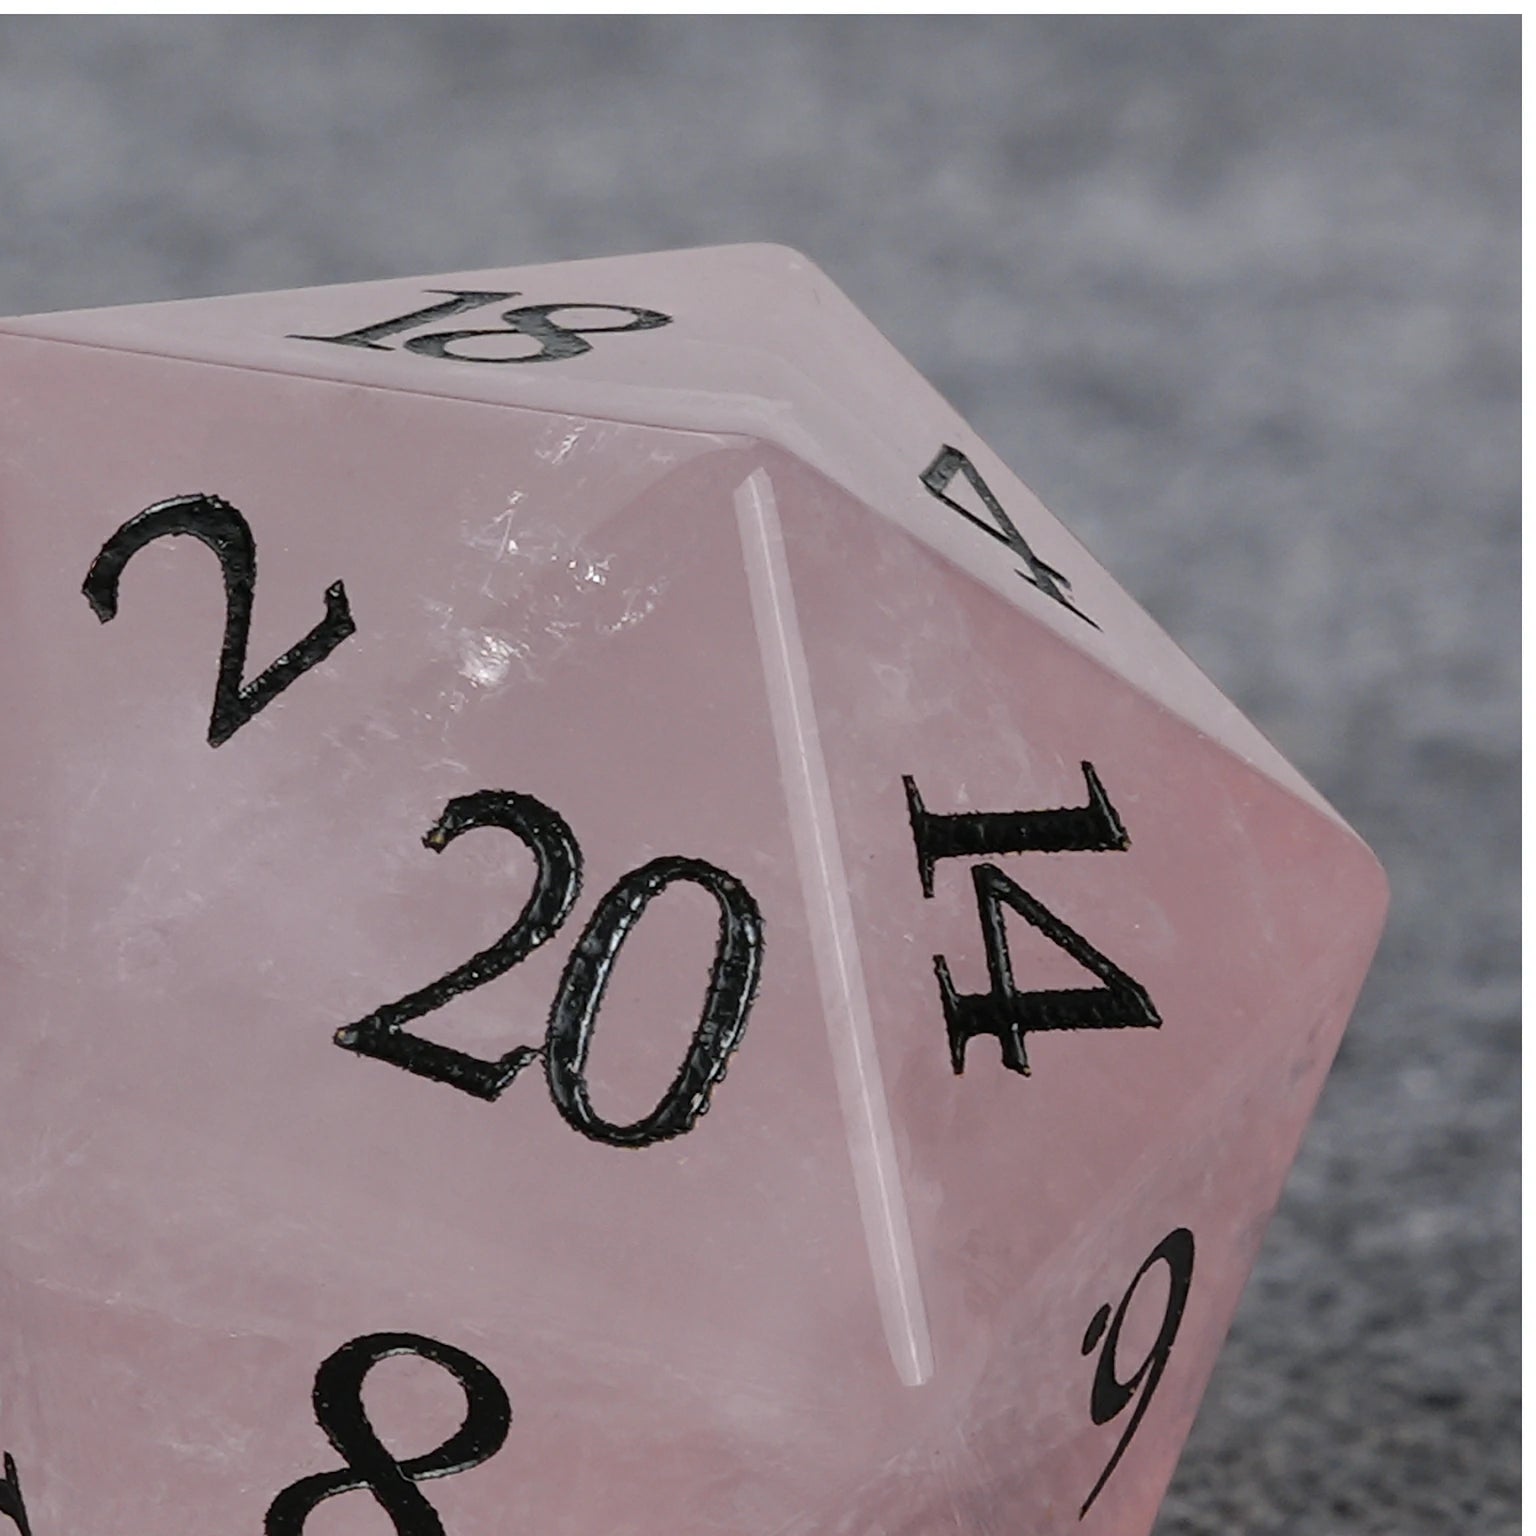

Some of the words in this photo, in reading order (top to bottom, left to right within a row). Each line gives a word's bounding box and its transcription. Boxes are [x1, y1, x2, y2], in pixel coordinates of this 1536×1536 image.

[286, 290, 673, 363] 18
[82, 493, 356, 748] 2
[333, 789, 765, 1149] 20
[902, 761, 1163, 1077] 14
